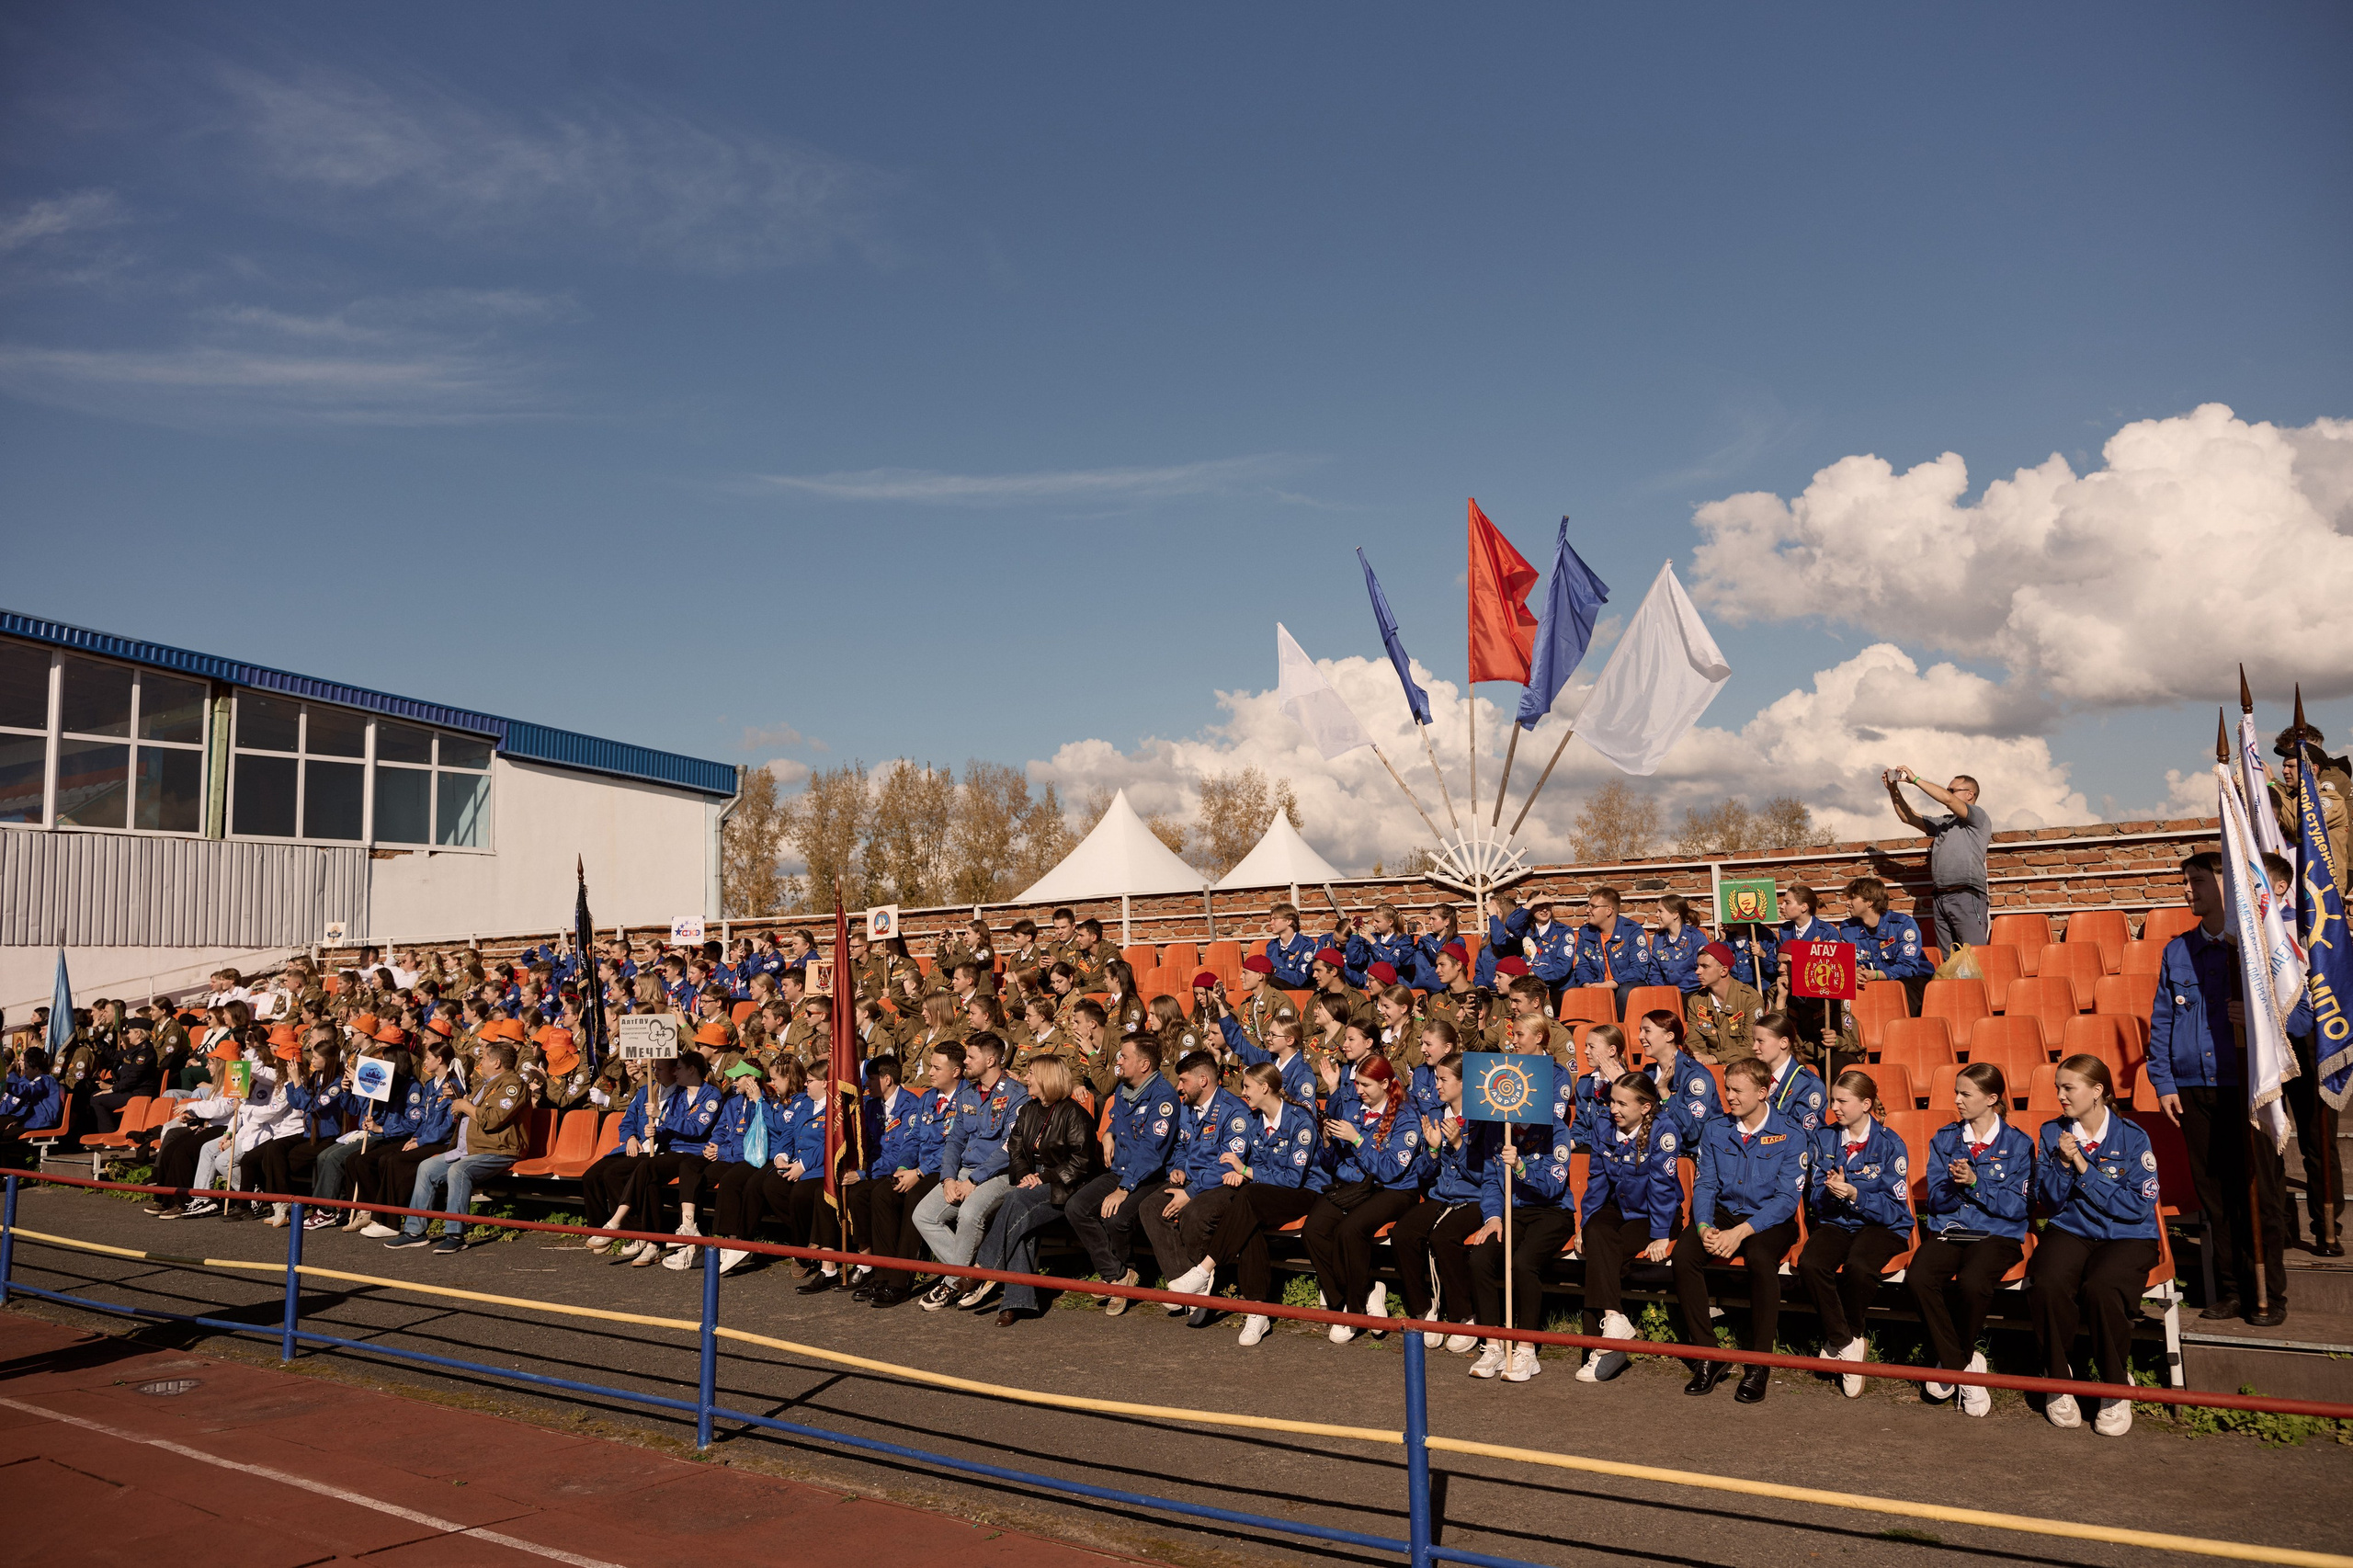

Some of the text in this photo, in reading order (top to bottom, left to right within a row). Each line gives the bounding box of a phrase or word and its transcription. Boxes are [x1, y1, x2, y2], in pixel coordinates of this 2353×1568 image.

[2305, 812, 2340, 890] студенчес
[1810, 944, 1837, 957] АГАУ
[1491, 1083, 1522, 1105] АВРОРА
